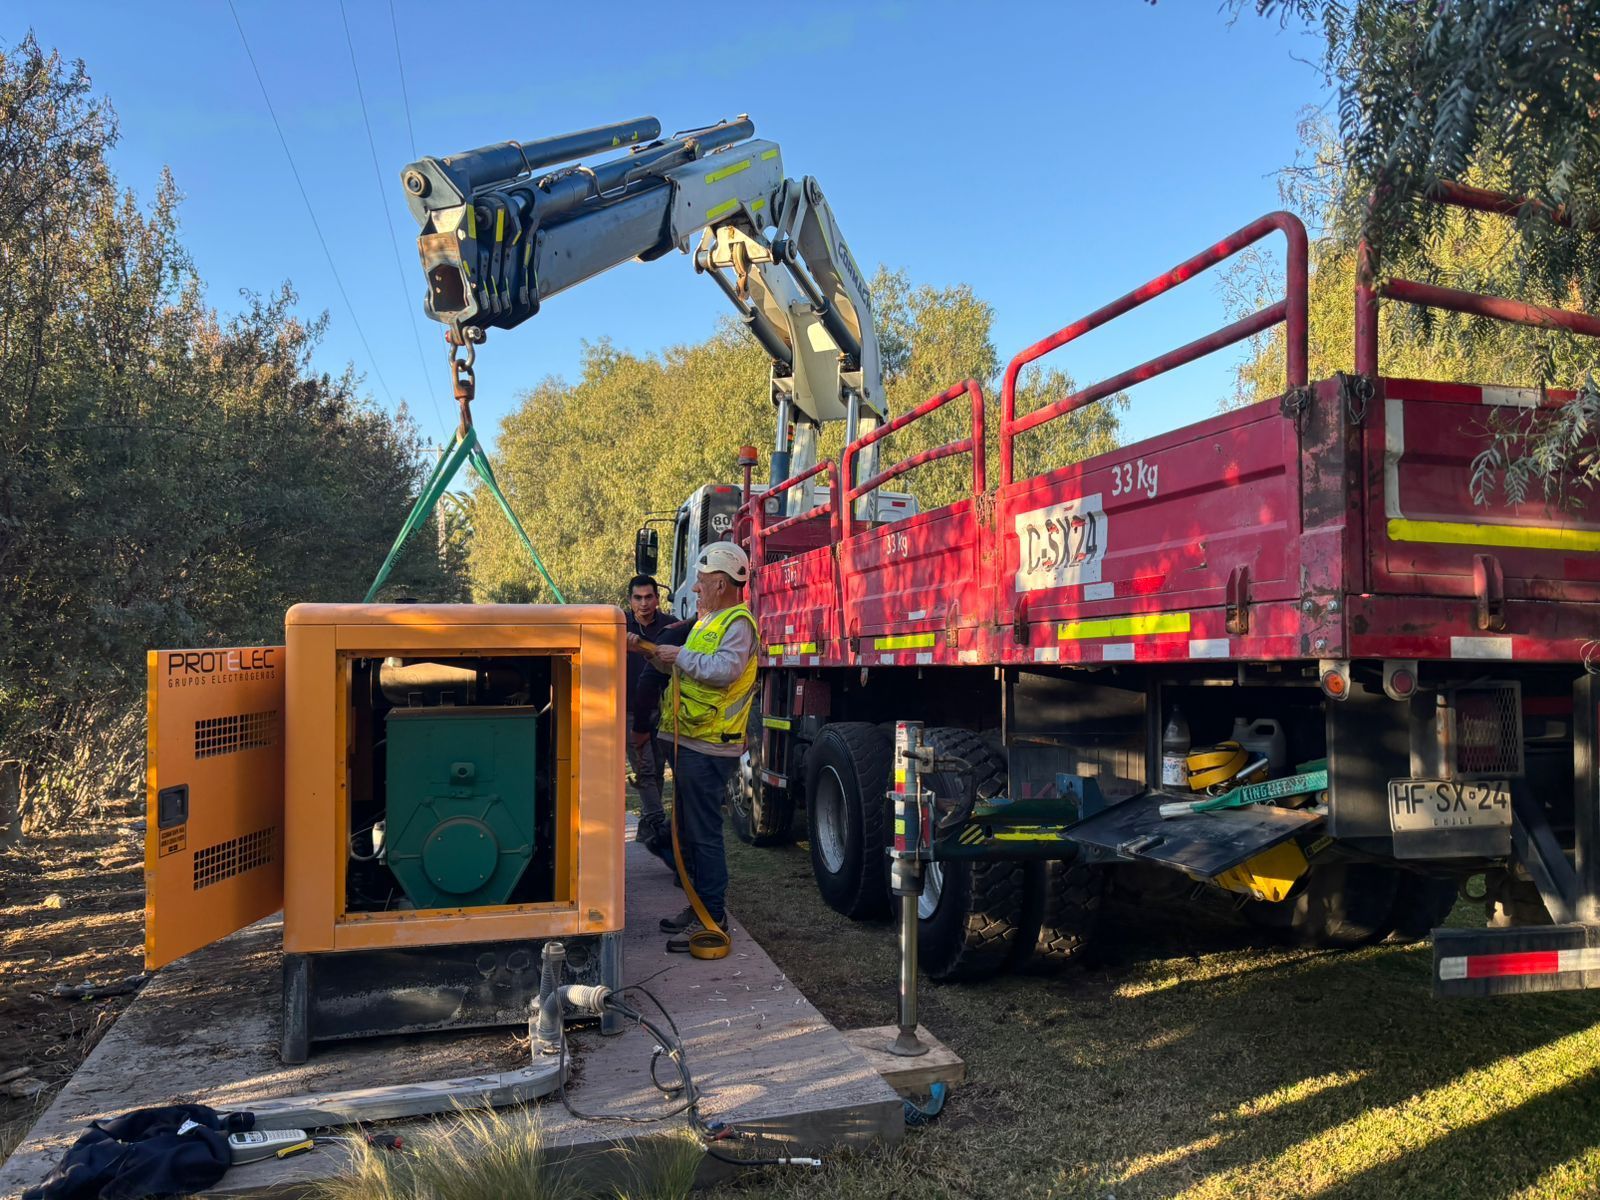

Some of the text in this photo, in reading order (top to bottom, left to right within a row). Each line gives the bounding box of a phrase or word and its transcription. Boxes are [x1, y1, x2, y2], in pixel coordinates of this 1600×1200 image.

[713, 516, 731, 526] 80
[168, 649, 275, 676] PROTELEC
[168, 676, 206, 688] GRUPOS
[1433, 816, 1473, 826] CHILE
